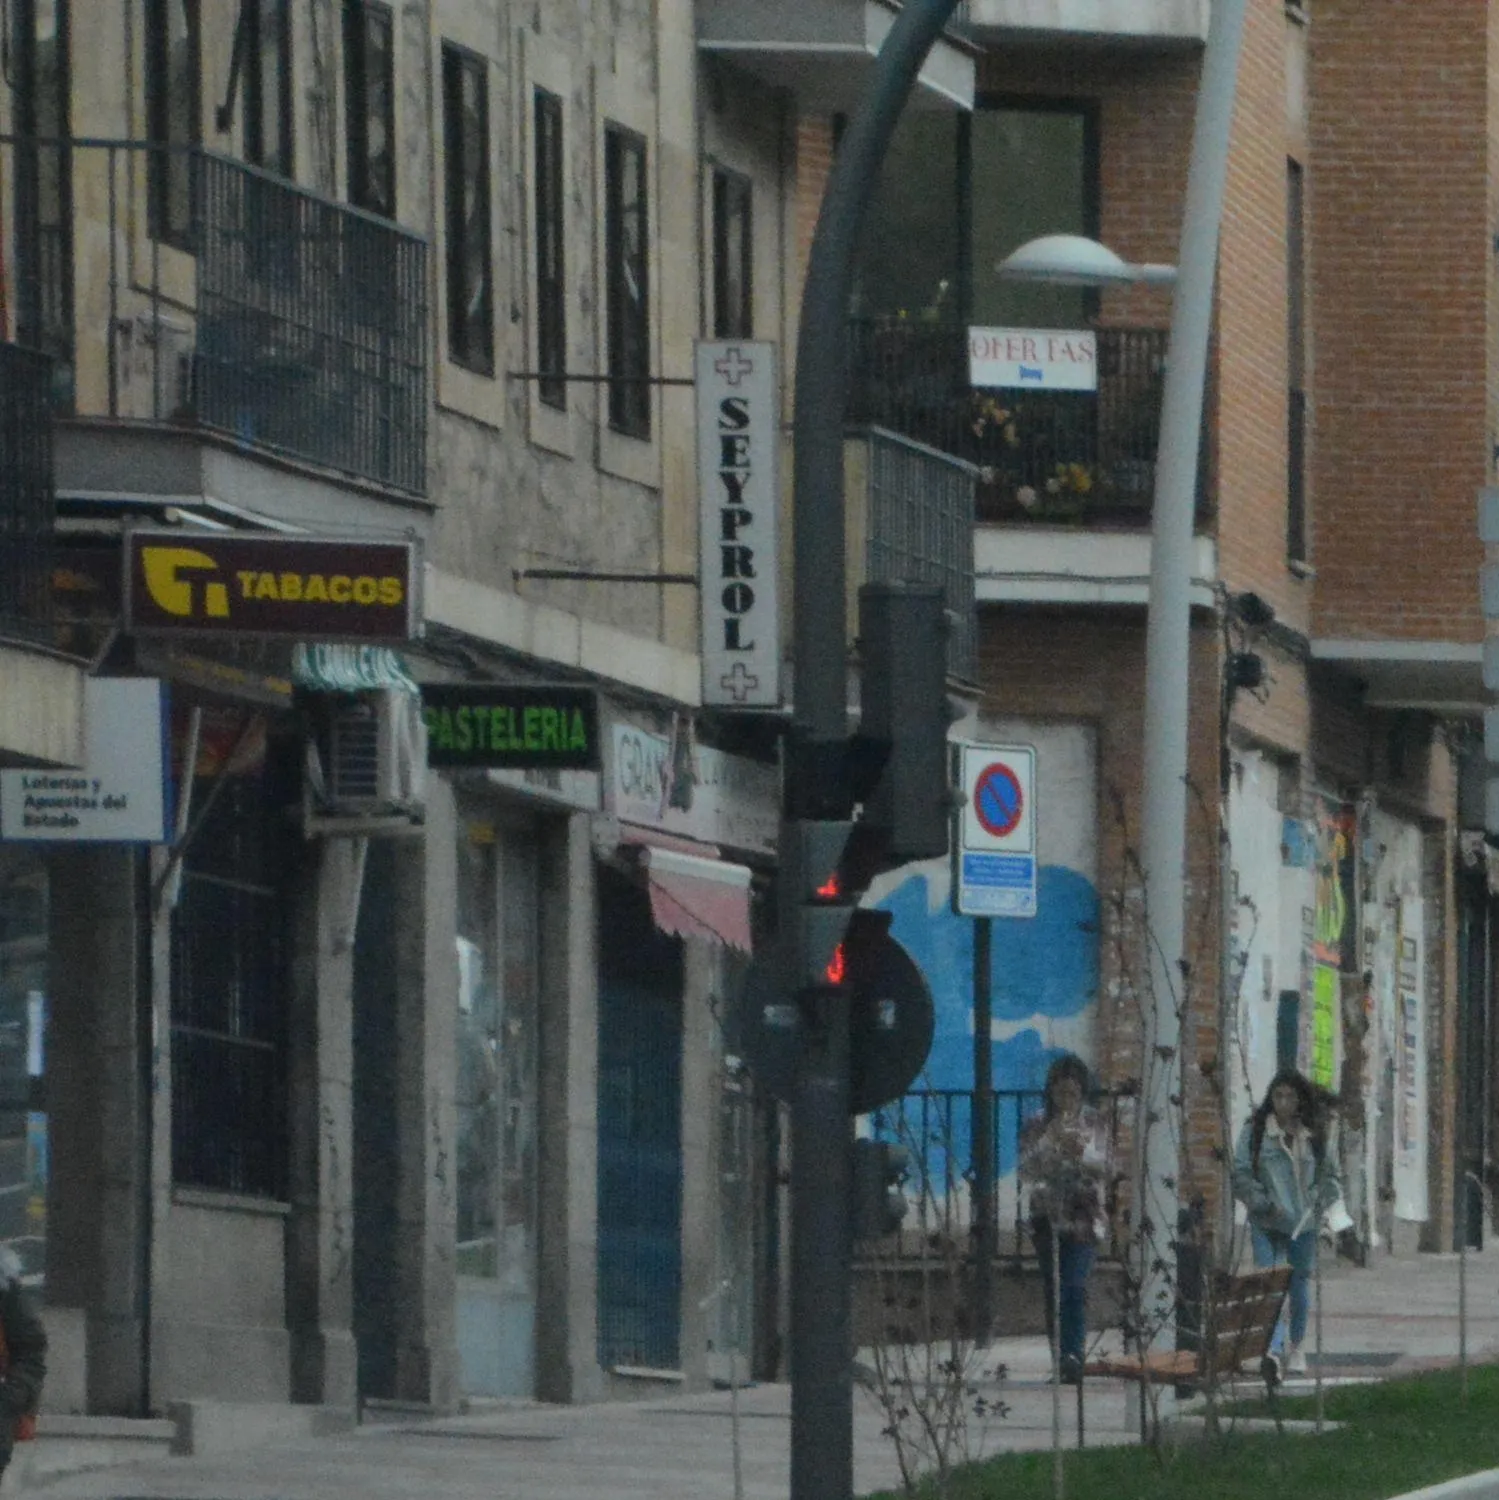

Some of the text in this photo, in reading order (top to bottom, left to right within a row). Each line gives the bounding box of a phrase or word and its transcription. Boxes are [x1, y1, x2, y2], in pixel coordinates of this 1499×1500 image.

[971, 335, 1094, 363] OFERTAS
[717, 396, 756, 652] SEYPROL
[236, 570, 404, 607] TABACOS
[103, 793, 128, 811] del
